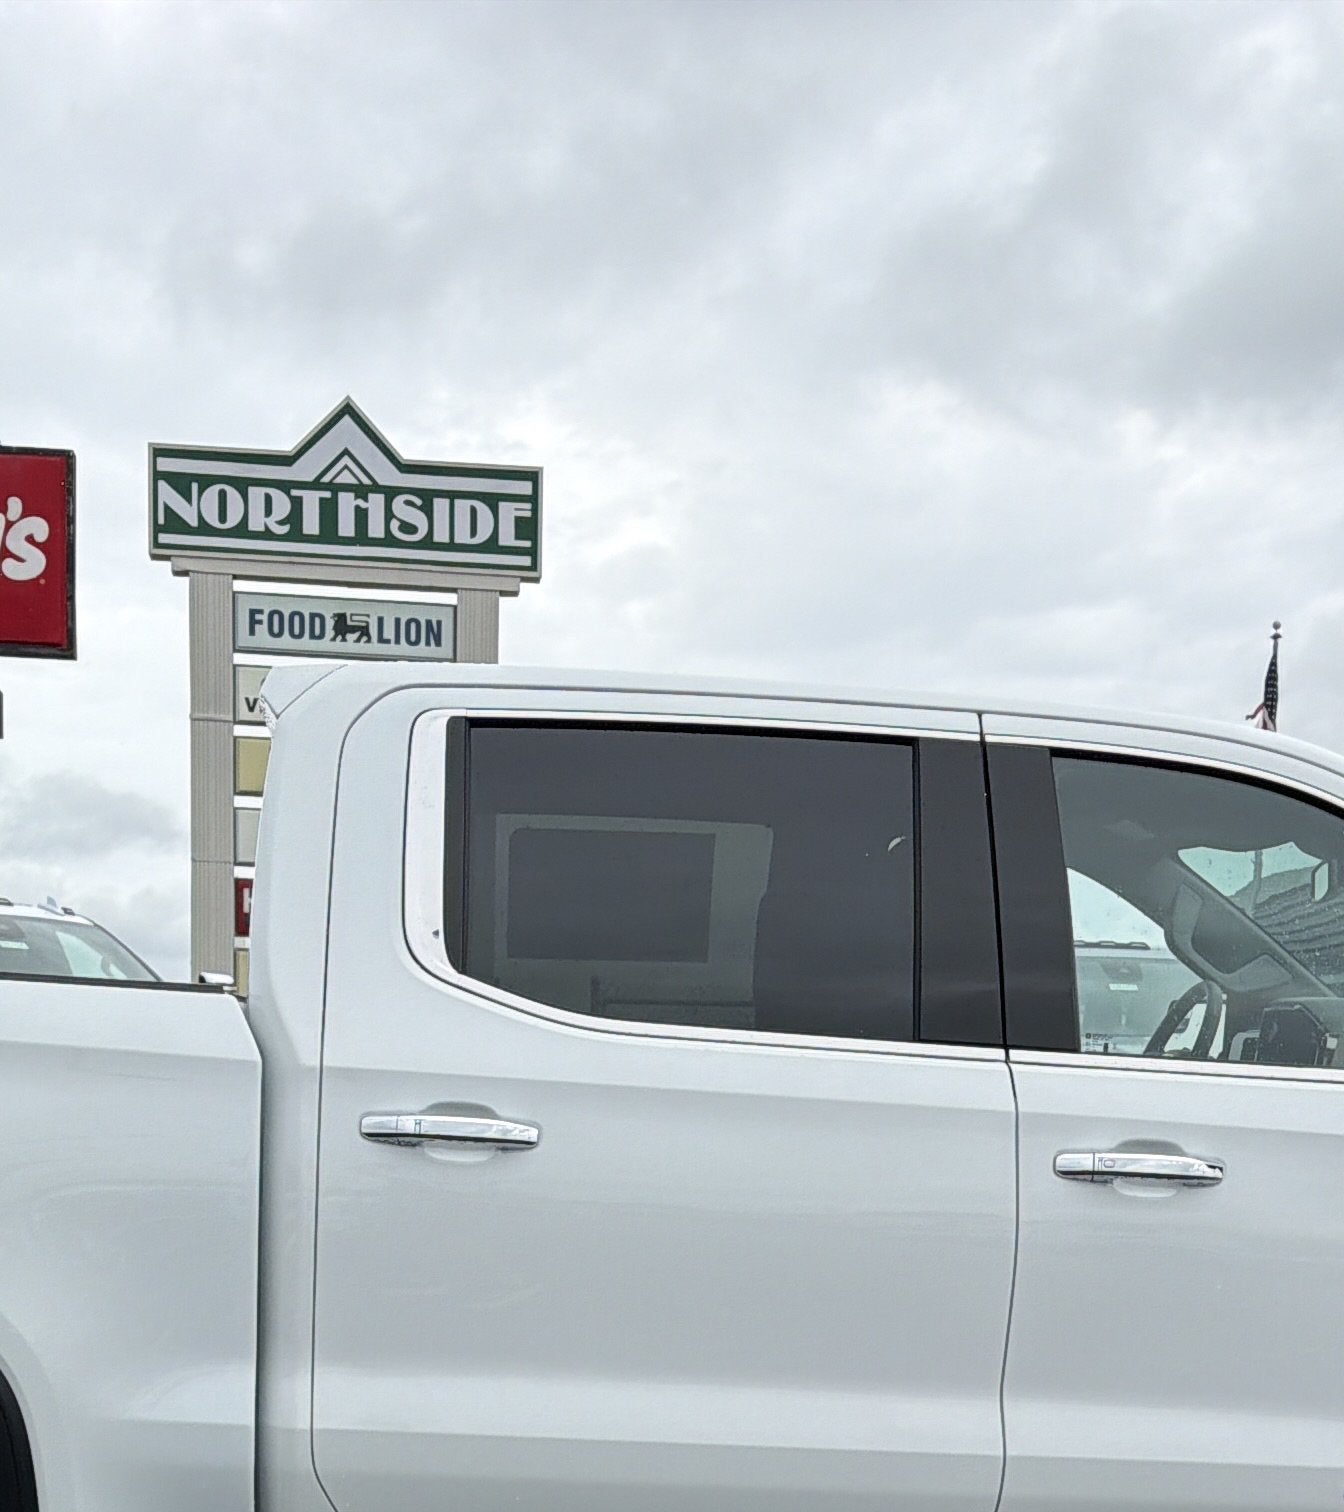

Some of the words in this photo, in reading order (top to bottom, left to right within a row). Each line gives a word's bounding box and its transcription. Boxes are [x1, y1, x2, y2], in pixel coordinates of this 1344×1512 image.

[157, 478, 533, 549] NORTHSIDE
[248, 607, 327, 642] FOOD
[377, 613, 443, 648] LION
